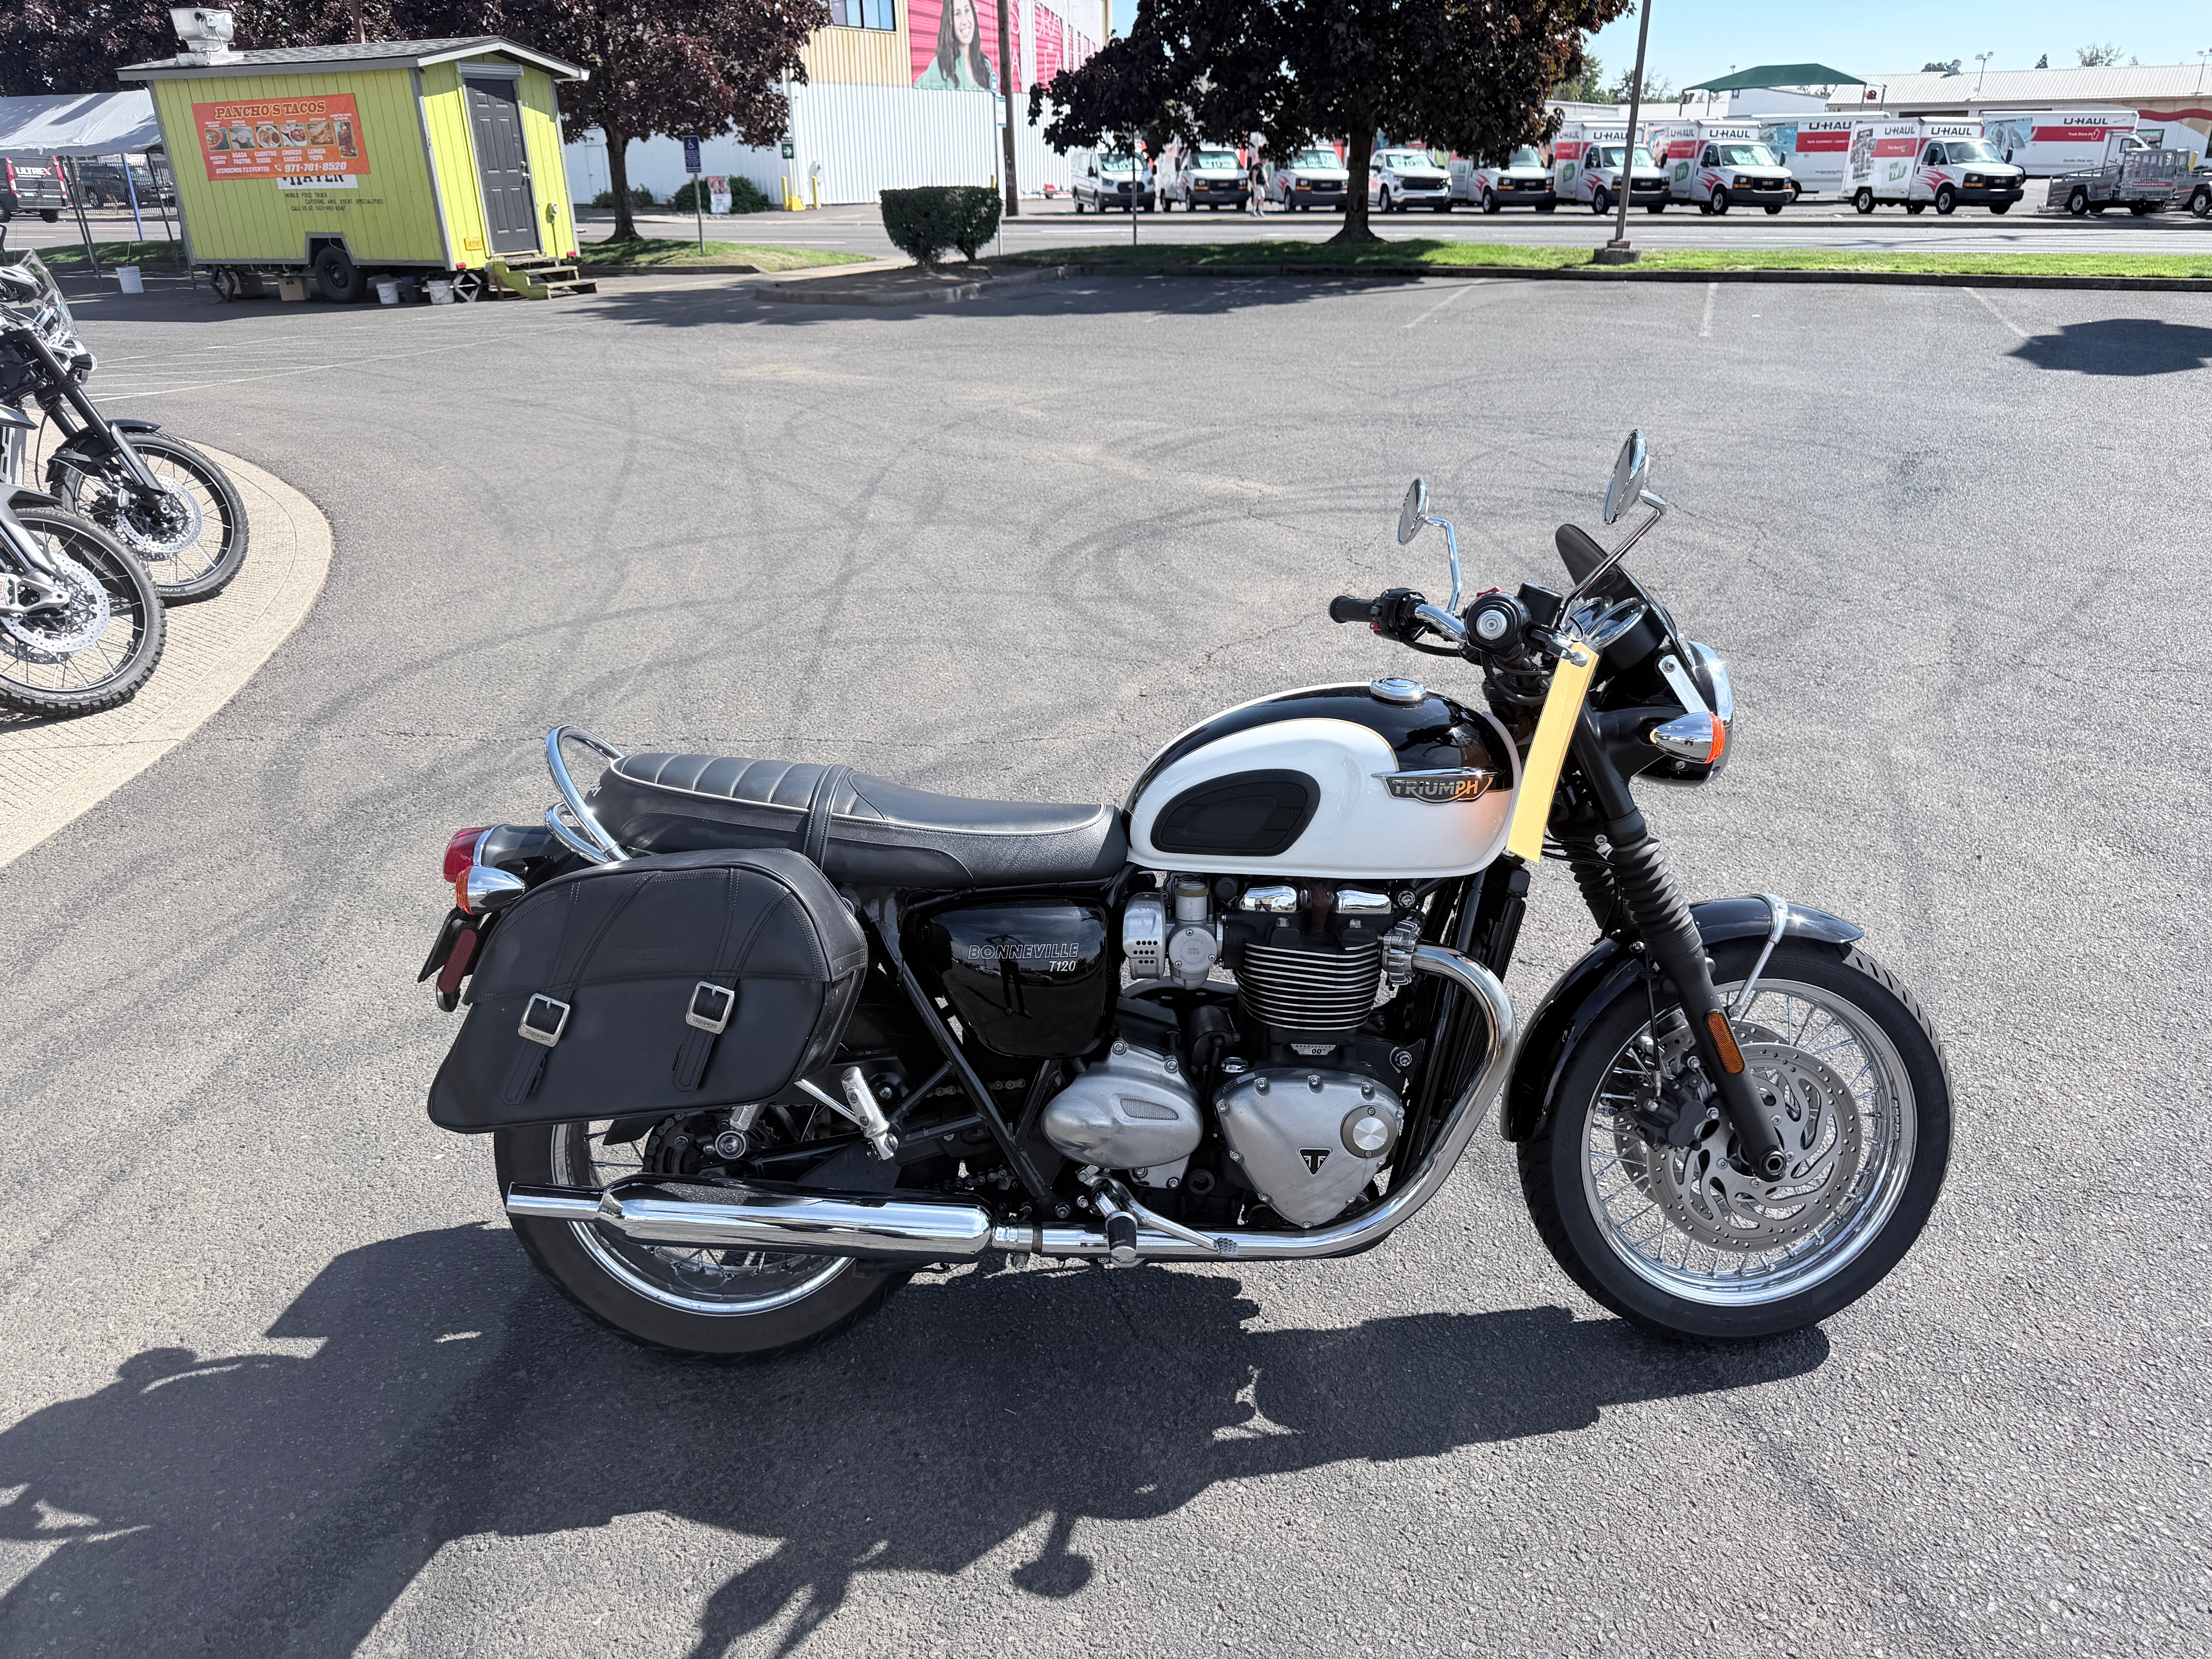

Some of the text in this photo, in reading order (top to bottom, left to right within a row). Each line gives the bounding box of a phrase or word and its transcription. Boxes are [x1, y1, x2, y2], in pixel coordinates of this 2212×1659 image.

[215, 100, 326, 119] PANCHO'S TACOS
[1809, 122, 1851, 130] U-HAU
[1885, 126, 1915, 135] U-HAUL
[1671, 128, 1694, 137] U-HAUL
[1710, 129, 1750, 138] U-HAUL
[1931, 127, 1972, 135] U-HAUL
[1594, 132, 1628, 140] U-HAU
[16, 507, 71, 520] MICHELIN
[1392, 780, 1479, 802] TRIUMPH
[968, 943, 1079, 959] BONNEVILLE
[1049, 960, 1076, 972] T120
